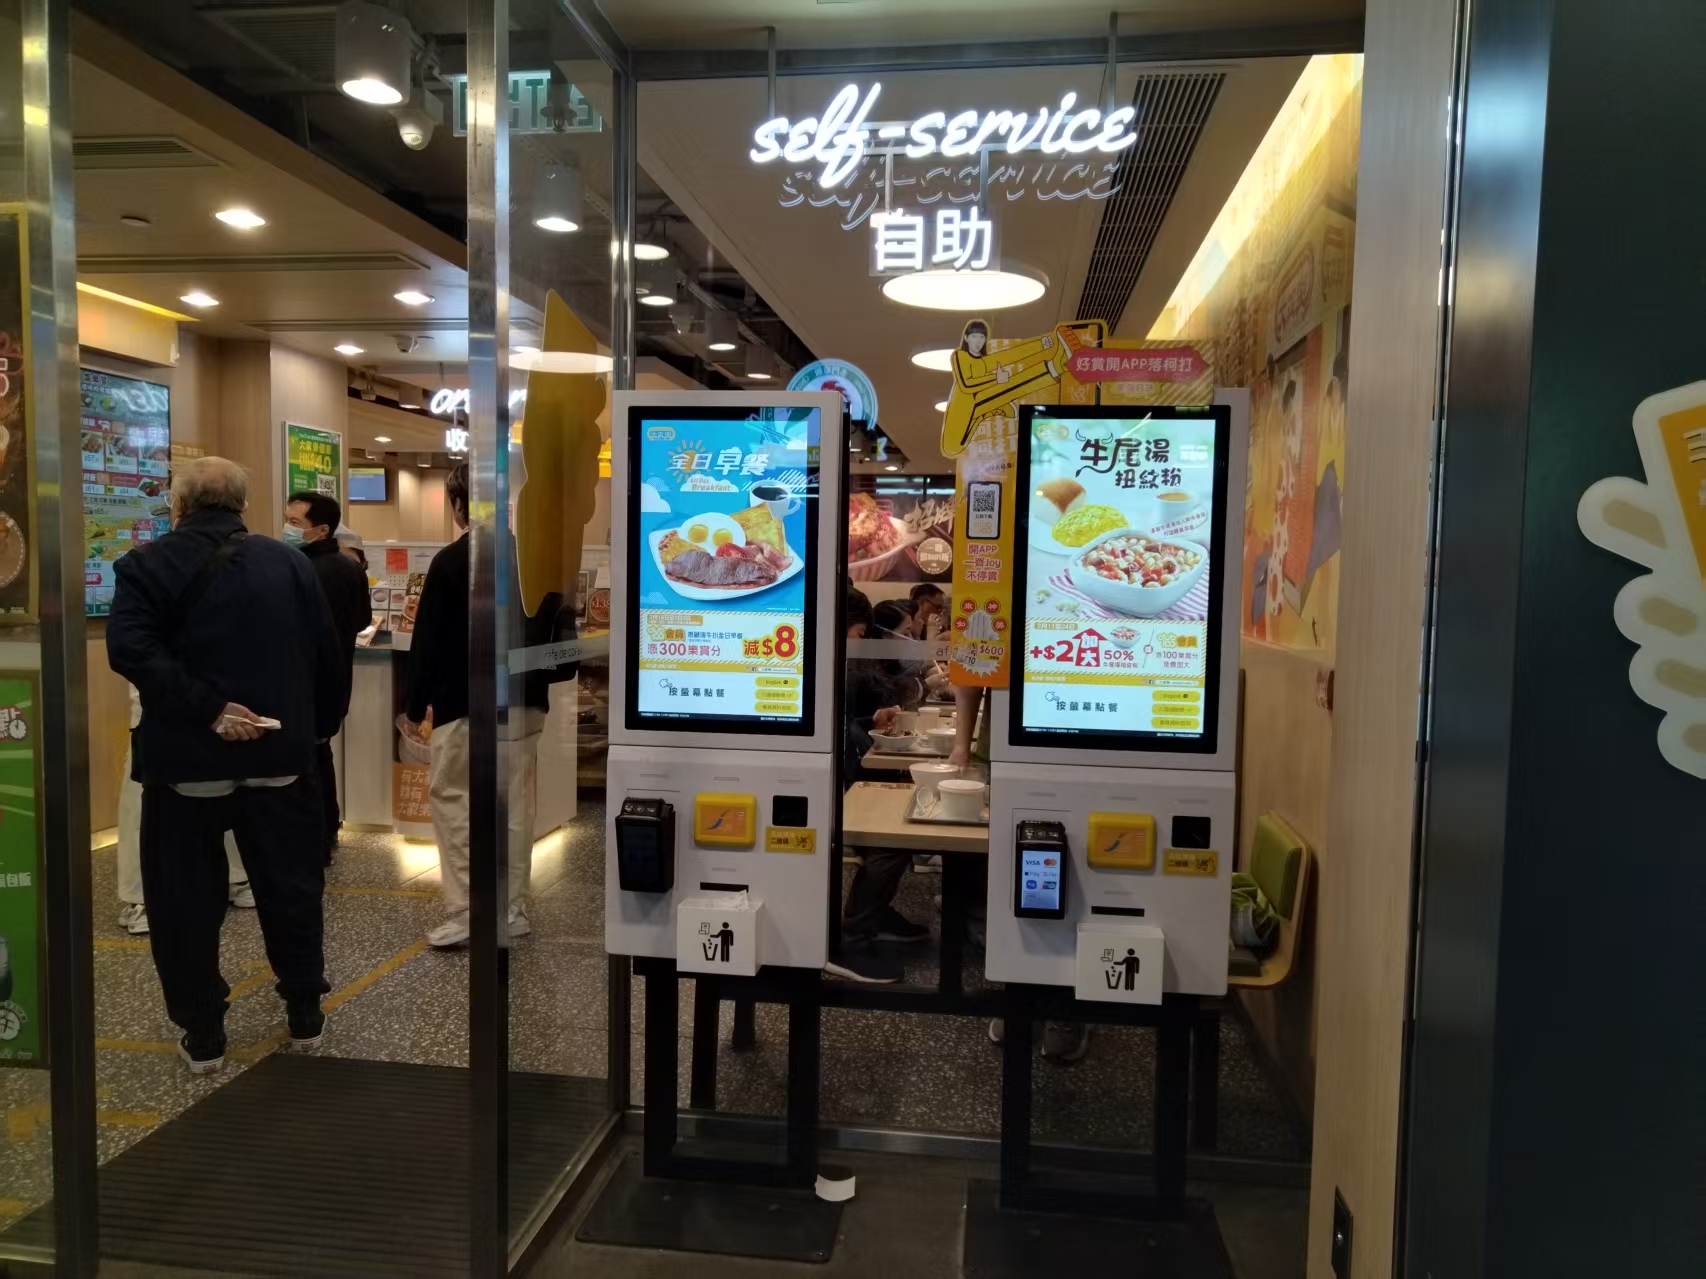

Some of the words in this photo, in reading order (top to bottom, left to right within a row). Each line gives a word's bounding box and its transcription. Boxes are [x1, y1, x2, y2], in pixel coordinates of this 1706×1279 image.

[750, 82, 1137, 189] self-service
[875, 206, 993, 272] 自助
[668, 448, 769, 476] 全日早餐
[1078, 436, 1170, 471] 牛尾湯
[691, 483, 731, 491] Breakfast
[968, 543, 998, 555] 開APP
[1103, 649, 1134, 661] 50%
